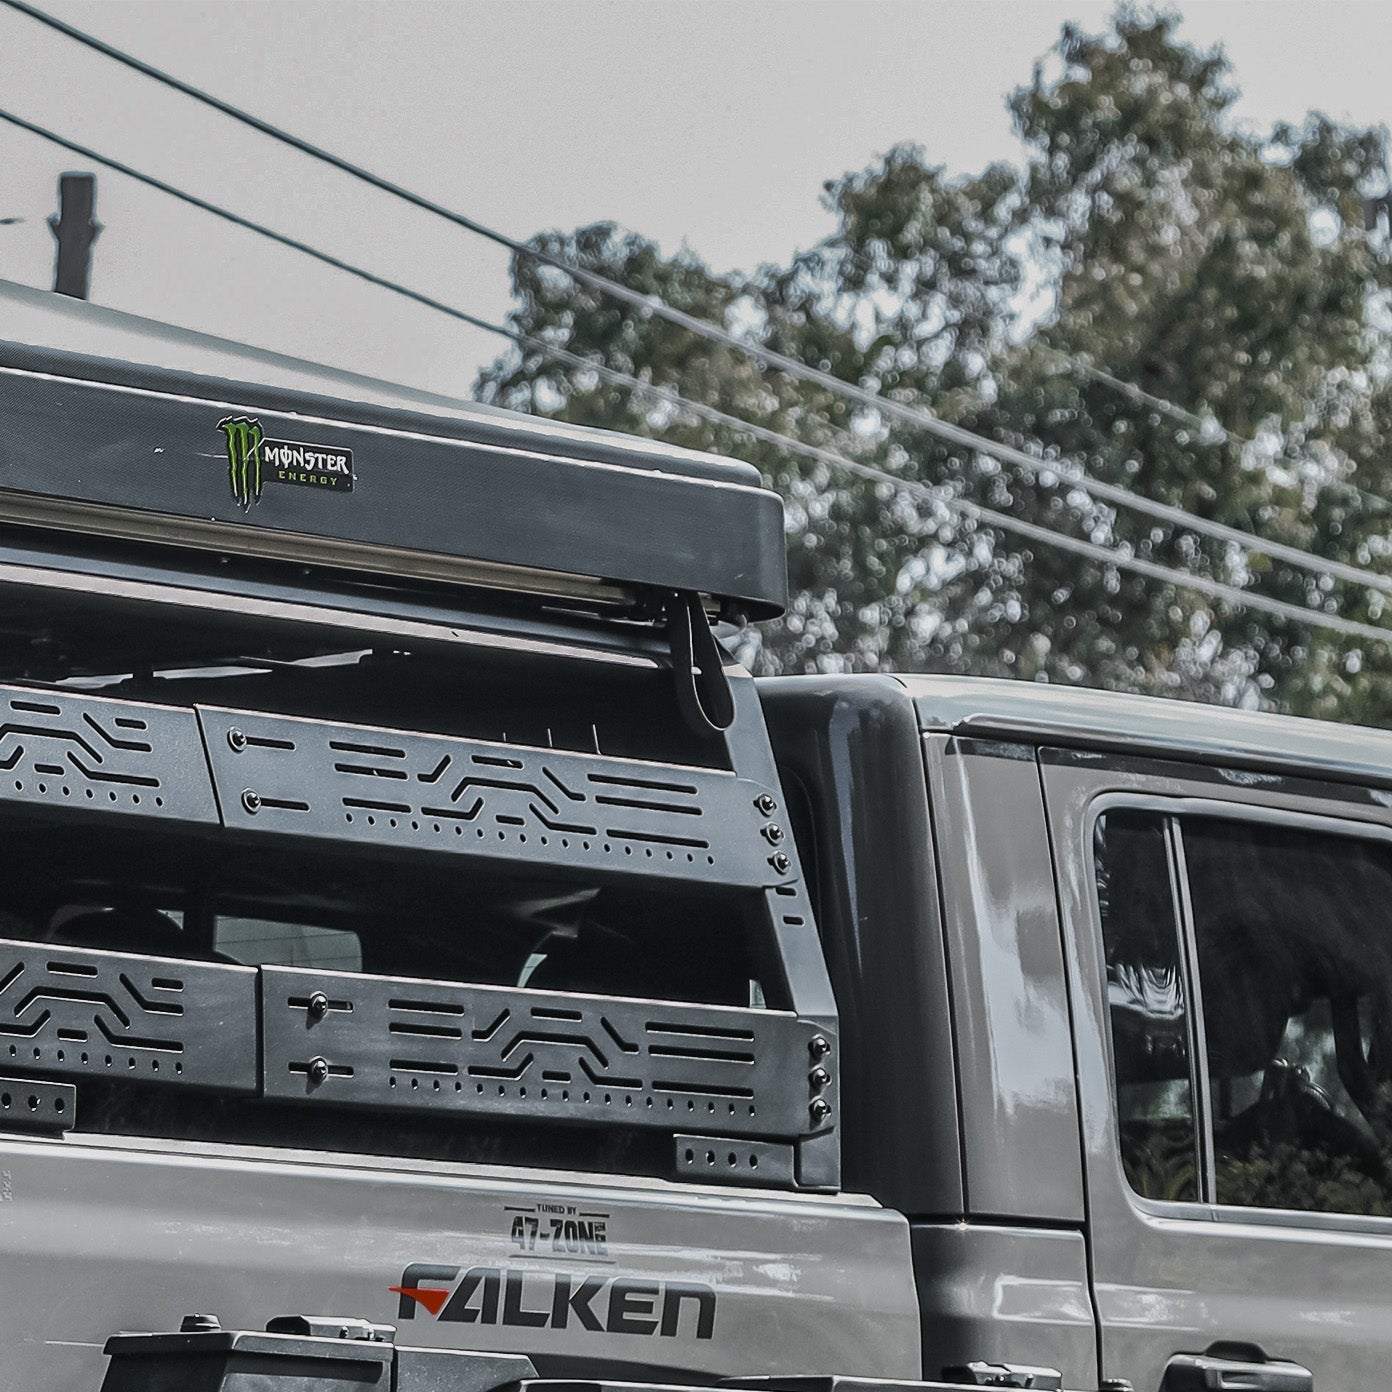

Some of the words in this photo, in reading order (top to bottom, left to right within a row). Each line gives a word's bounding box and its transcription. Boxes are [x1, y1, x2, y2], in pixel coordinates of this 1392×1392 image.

[264, 446, 349, 474] MONSTER
[279, 470, 338, 486] ENERGY
[537, 1203, 565, 1214] TUNED
[567, 1206, 577, 1215] BY
[511, 1216, 608, 1256] 47-ZONE
[389, 1261, 717, 1341] FALKEN
